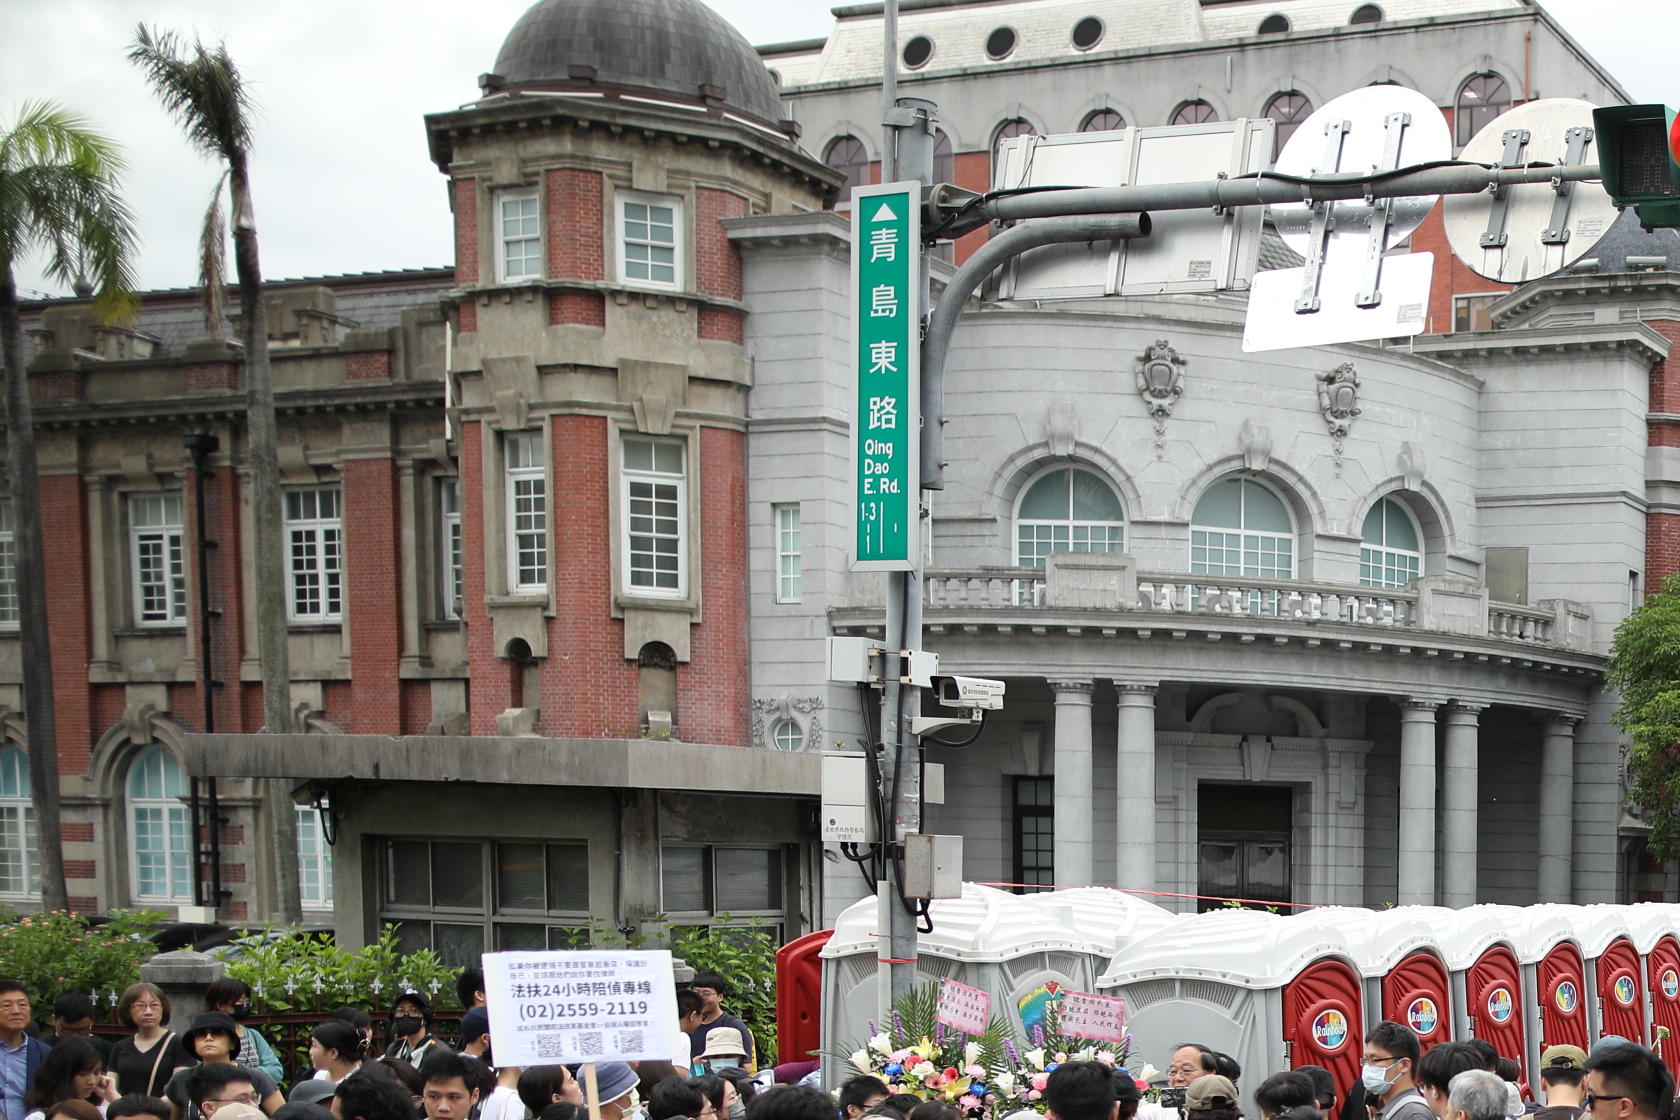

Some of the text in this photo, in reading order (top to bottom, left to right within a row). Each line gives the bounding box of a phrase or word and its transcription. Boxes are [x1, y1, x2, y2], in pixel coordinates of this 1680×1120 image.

[869, 227, 899, 430] 青島東路
[864, 439, 893, 459] Qing
[864, 459, 890, 475] Dao
[864, 477, 901, 494] E. Rd.
[511, 981, 653, 998] 法扶24小時陪偵專線
[519, 1000, 648, 1021] (02)2559-2119
[1316, 1023, 1345, 1037] Rainbow
